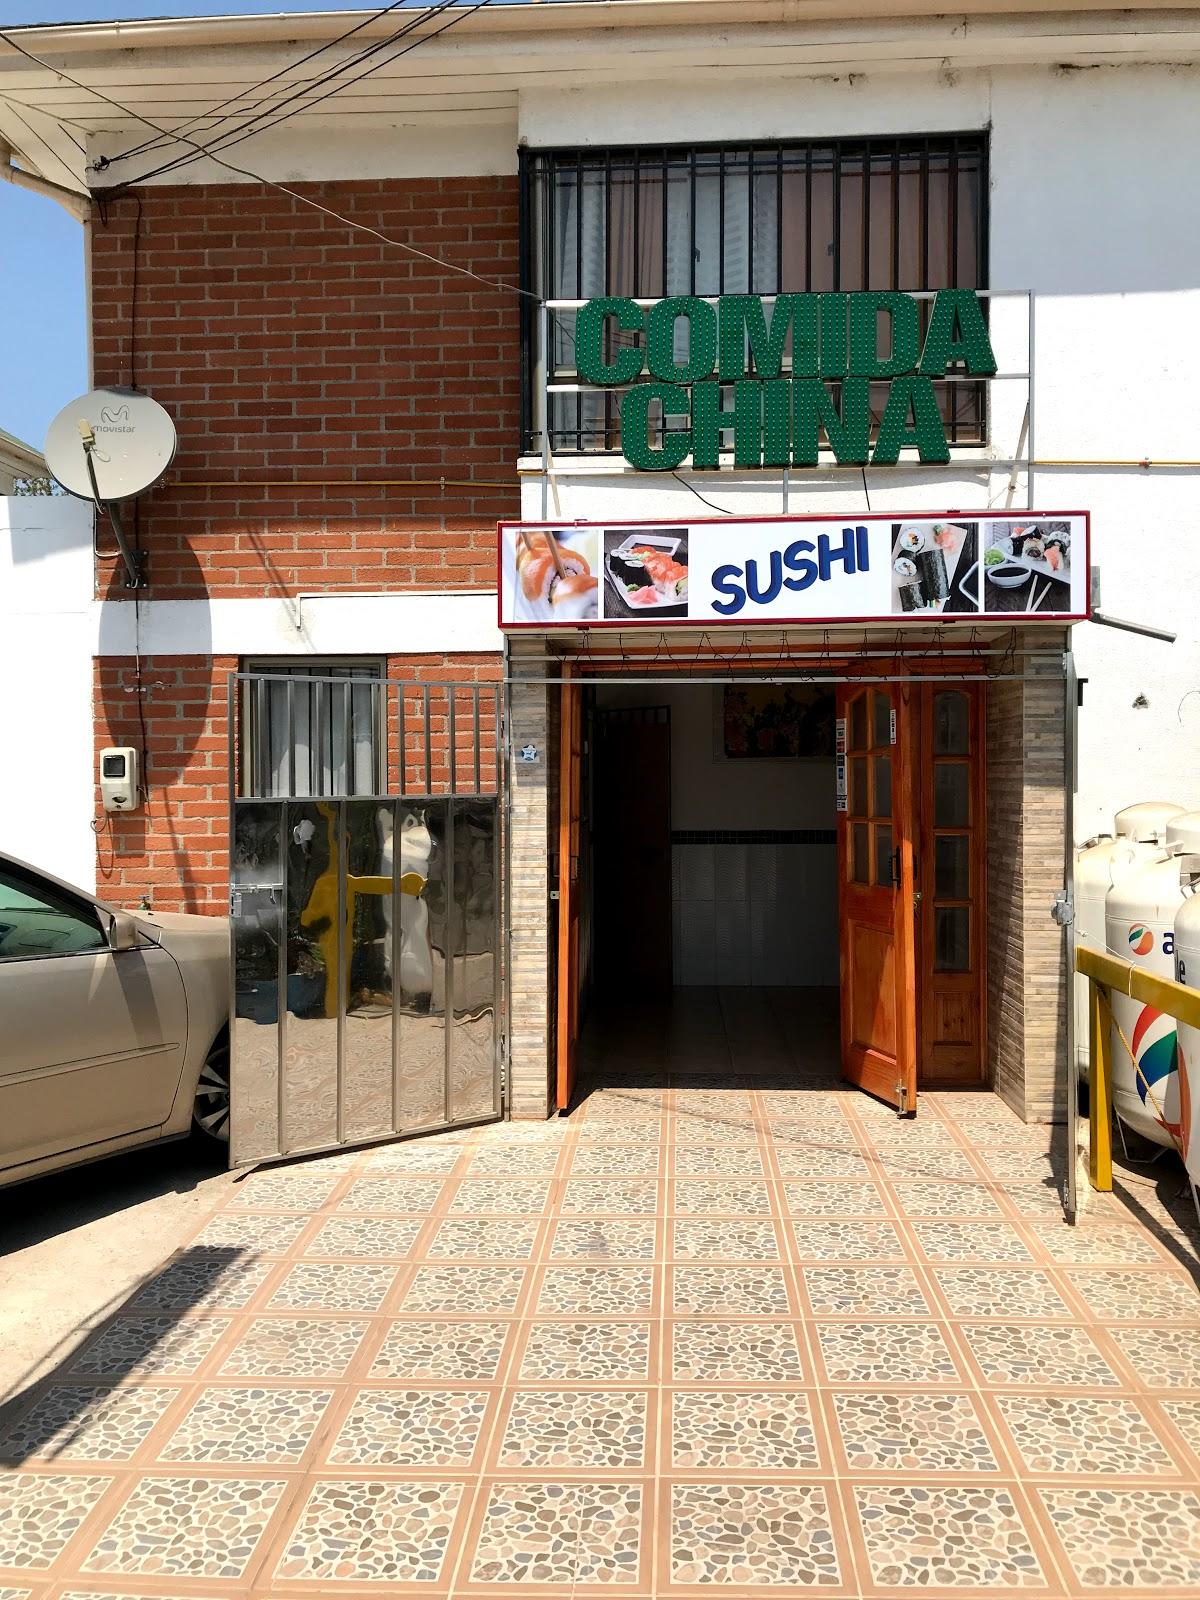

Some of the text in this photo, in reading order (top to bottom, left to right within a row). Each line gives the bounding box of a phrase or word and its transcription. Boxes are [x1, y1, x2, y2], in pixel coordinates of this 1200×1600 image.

[575, 288, 998, 386] COMIDA
[92, 425, 136, 433] movistar
[620, 376, 952, 471] CHINA
[711, 526, 870, 615] SUSHI
